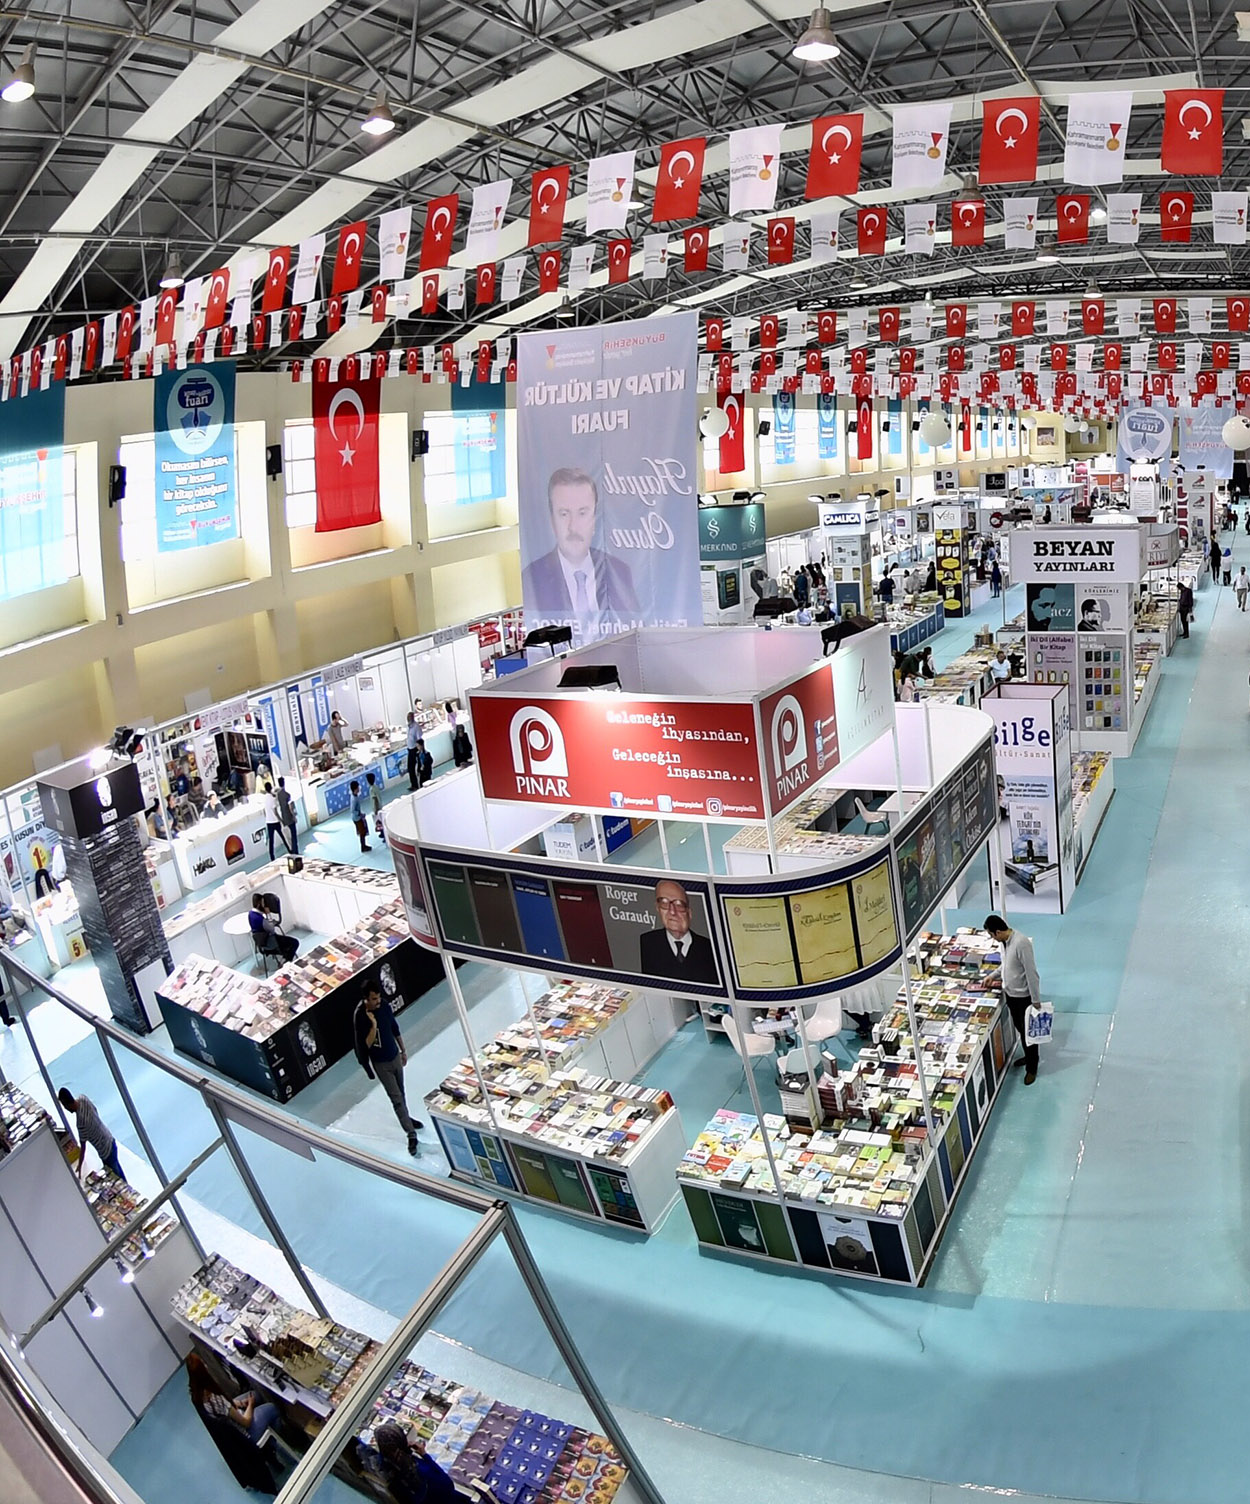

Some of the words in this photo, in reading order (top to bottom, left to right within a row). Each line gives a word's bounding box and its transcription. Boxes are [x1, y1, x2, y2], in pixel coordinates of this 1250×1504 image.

[1033, 541, 1115, 557] BEYAN
[1033, 562, 1115, 572] YAYINLARI
[1051, 608, 1072, 617] acz
[606, 710, 676, 727] Geleneğin
[661, 727, 750, 745] ihyasından,
[612, 749, 681, 766] Geleceğin
[666, 766, 755, 783] inşasına...
[776, 762, 810, 801] PINAR
[515, 775, 571, 798] PINAR
[611, 819, 629, 834] tudem
[553, 841, 571, 849] TUDEM
[605, 885, 638, 903] Roger
[609, 906, 656, 930] Garaudy
